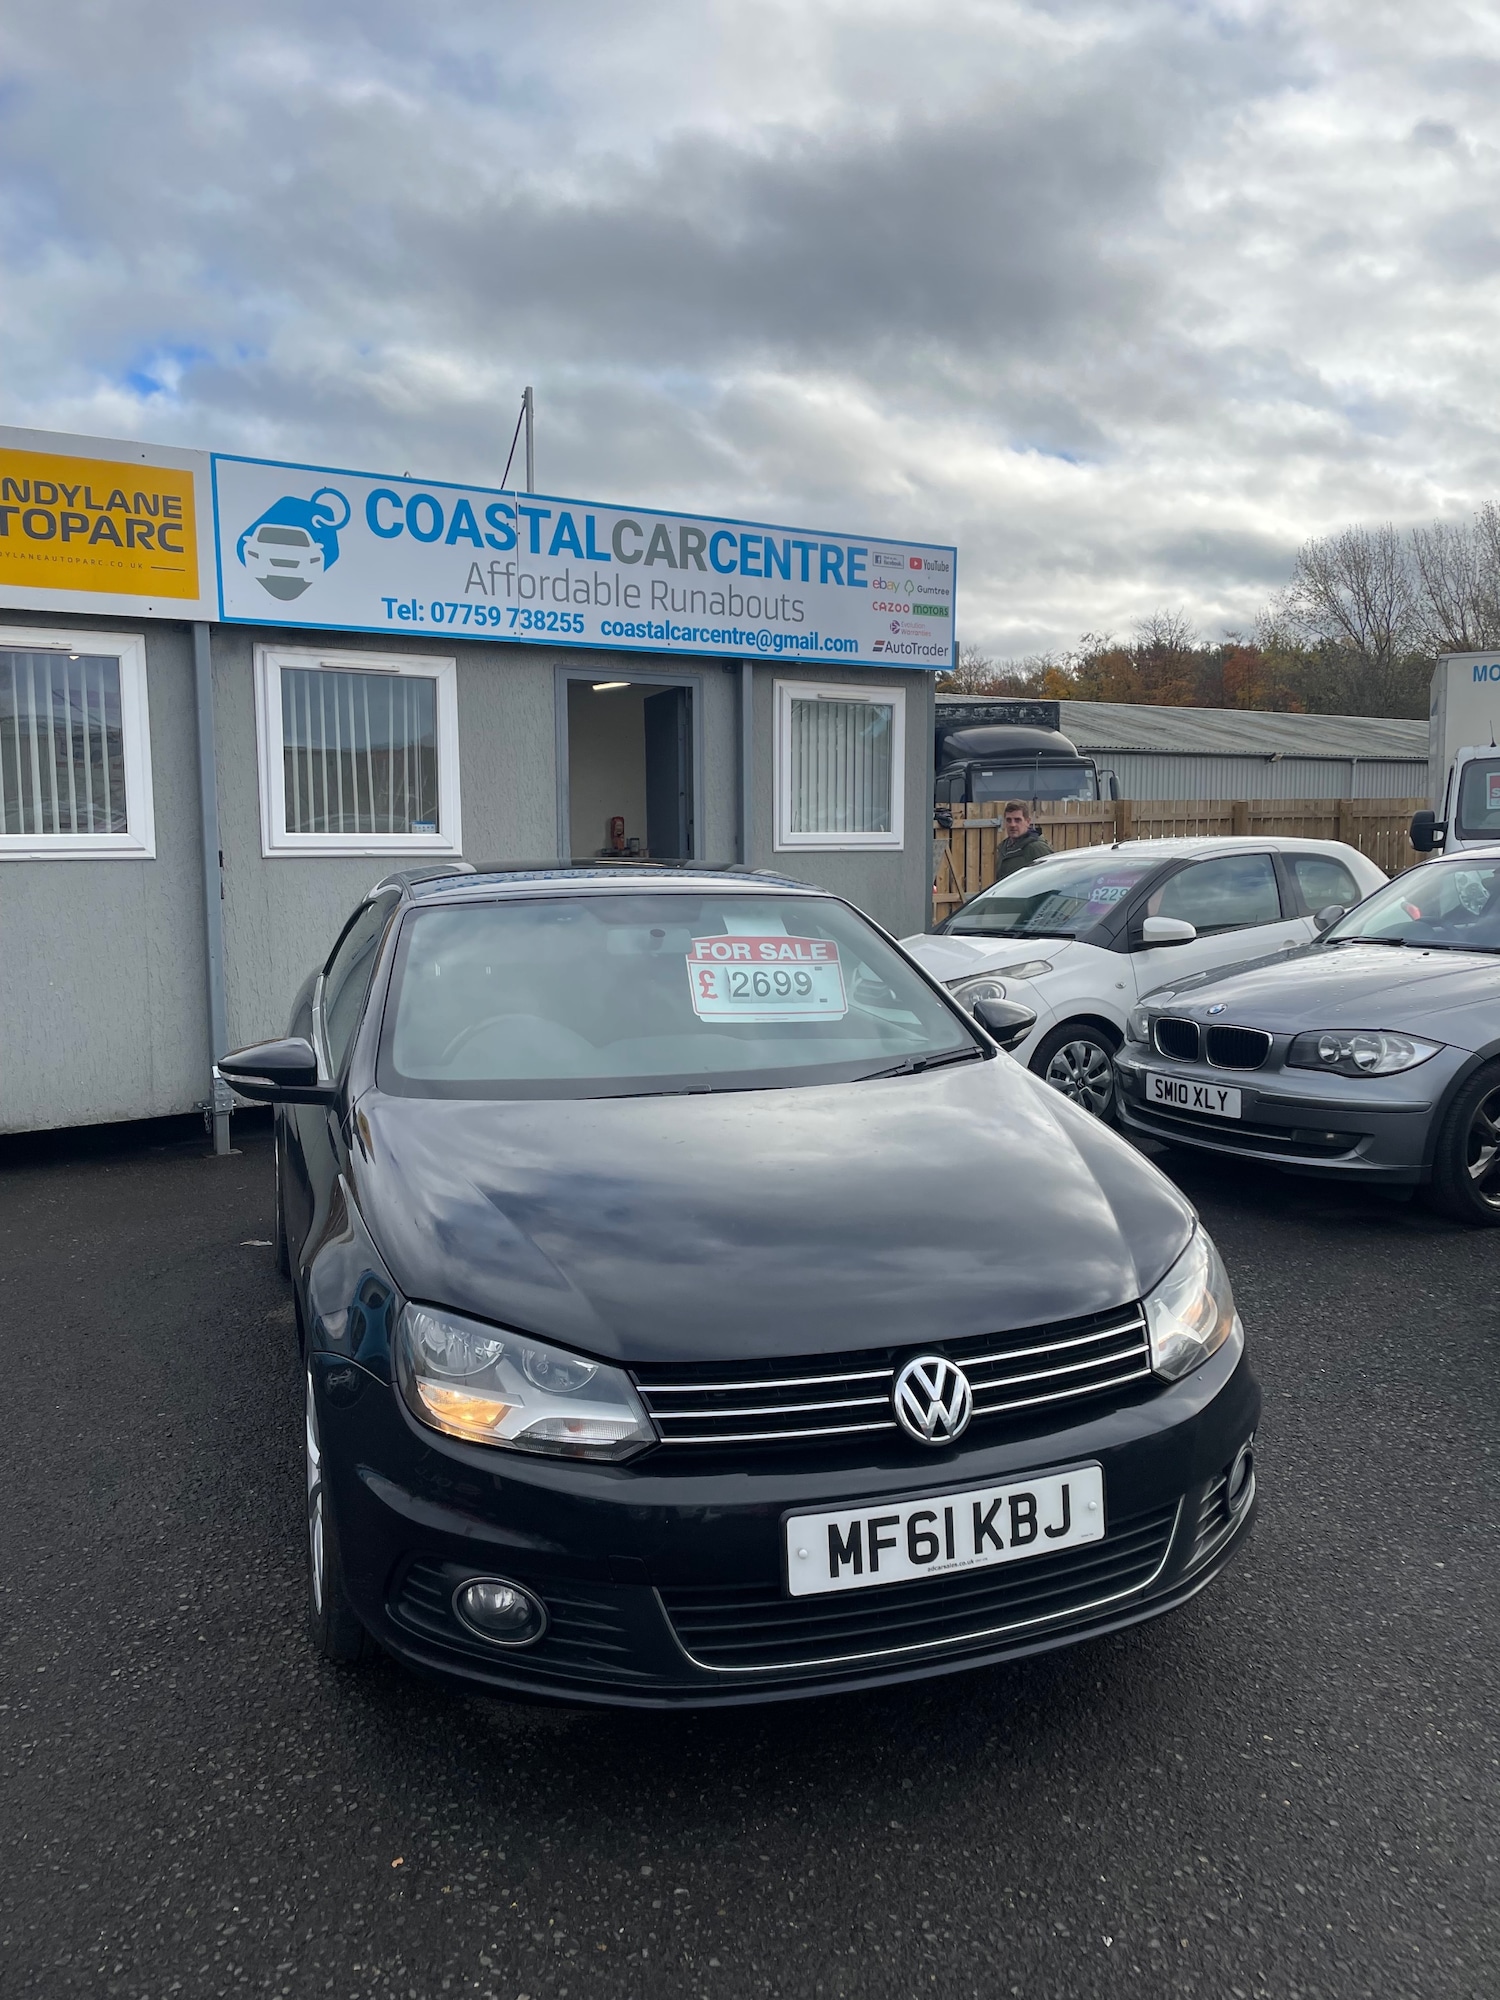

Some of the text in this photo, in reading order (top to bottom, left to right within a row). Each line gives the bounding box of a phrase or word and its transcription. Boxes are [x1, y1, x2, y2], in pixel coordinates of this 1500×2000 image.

[2, 477, 182, 519] NDYLANE
[365, 488, 868, 588] COASTALCARCENTRE
[923, 559, 949, 573] YouTube
[465, 560, 805, 623] Affordable Runabouts
[872, 577, 900, 593] ebay
[917, 585, 949, 596] Gumtree
[872, 602, 909, 613] CAZOO
[381, 598, 858, 654] Tel: 07759 738255 coastalcarcentre@gmail.com
[885, 641, 948, 656] AutoTrader
[695, 943, 828, 960] FOR SALE
[698, 969, 813, 999] £ 2699
[1155, 1079, 1228, 1111] SM10 XLY
[827, 1484, 1071, 1578] MF61 KBJ
